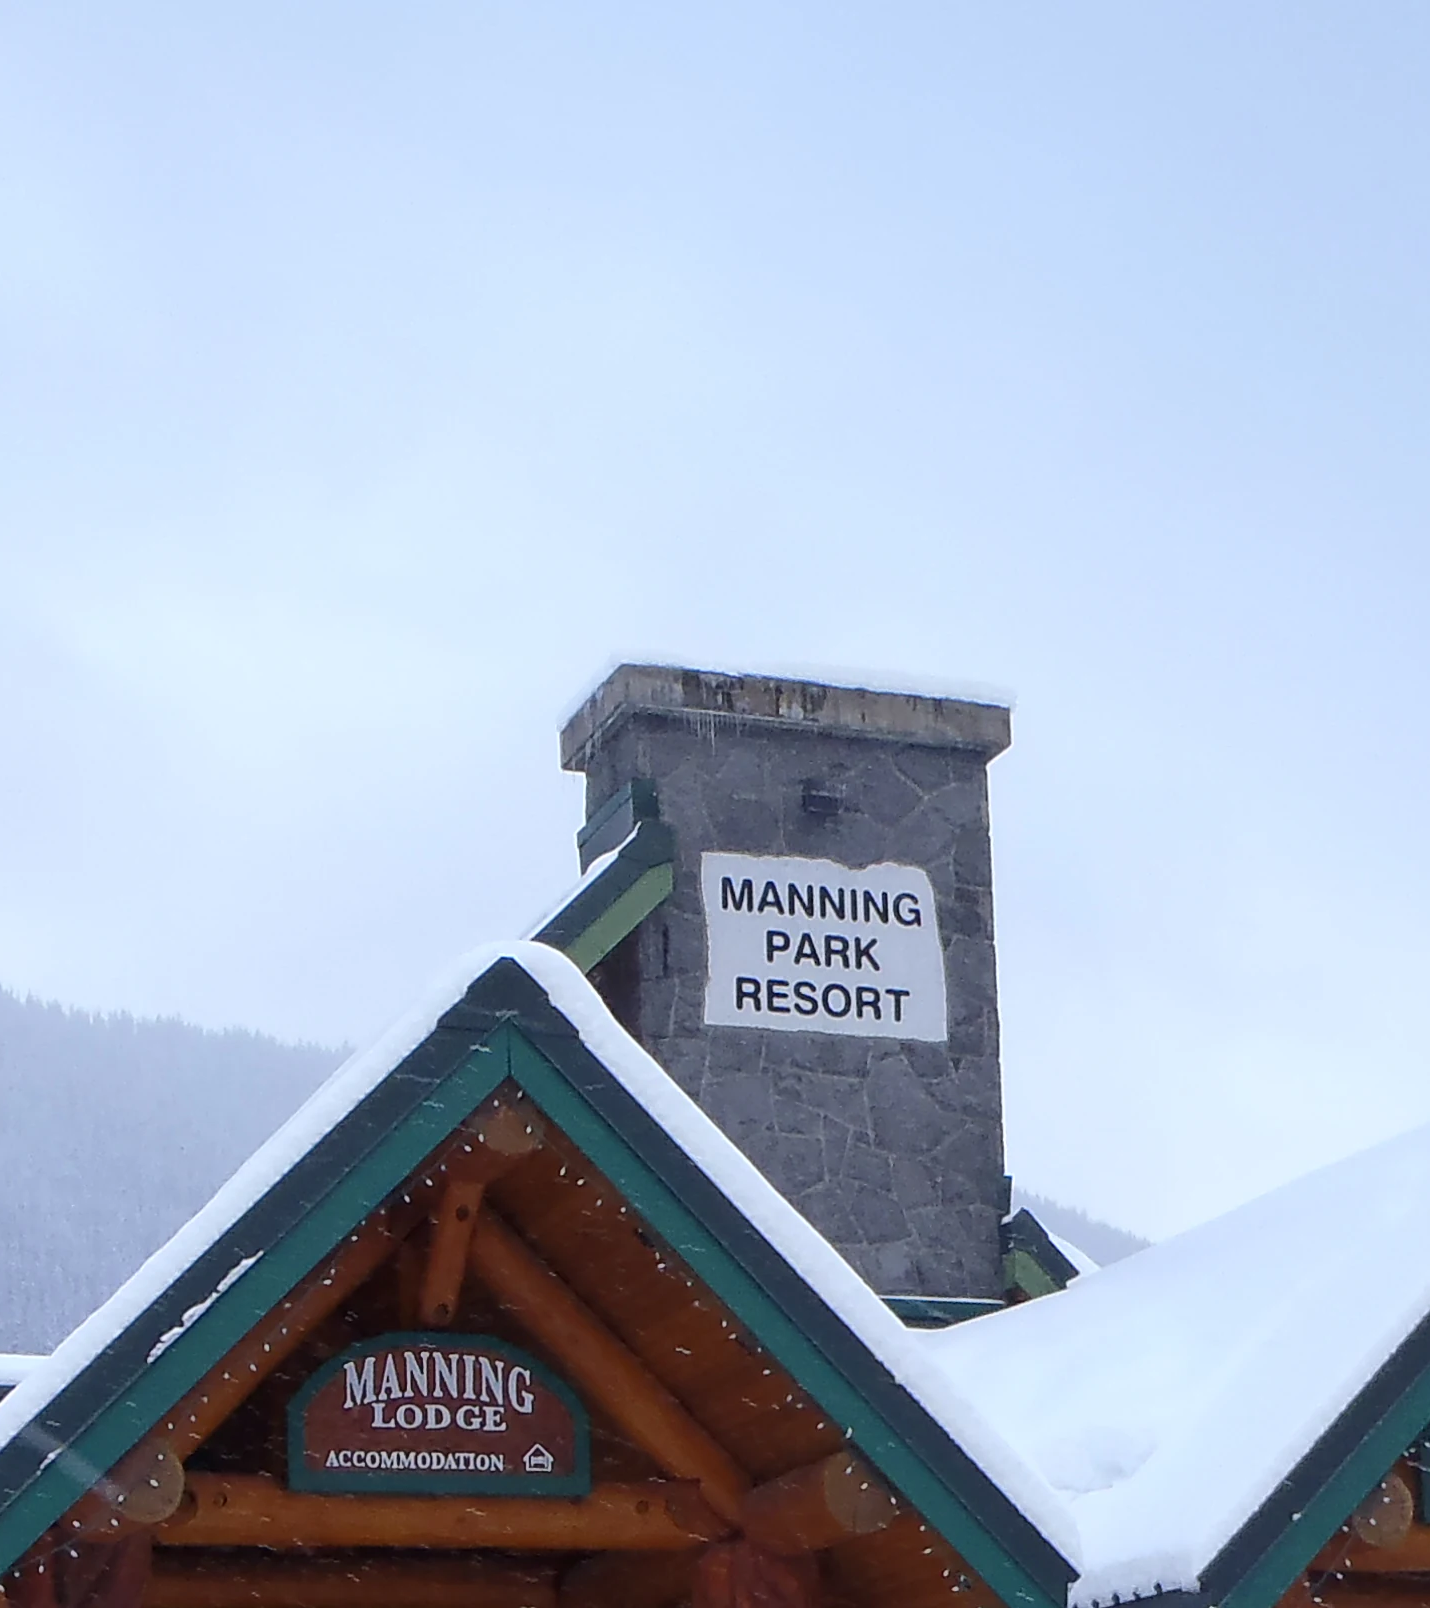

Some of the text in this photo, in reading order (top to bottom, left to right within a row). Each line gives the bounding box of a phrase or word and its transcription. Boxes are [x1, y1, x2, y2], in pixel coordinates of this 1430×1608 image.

[720, 875, 922, 928] MANNING
[765, 930, 881, 972] PARK
[734, 976, 911, 1023] RESORT
[342, 1351, 535, 1414] MANNING
[370, 1402, 508, 1432] LODGE
[324, 1449, 505, 1473] ACCOMMODATION
